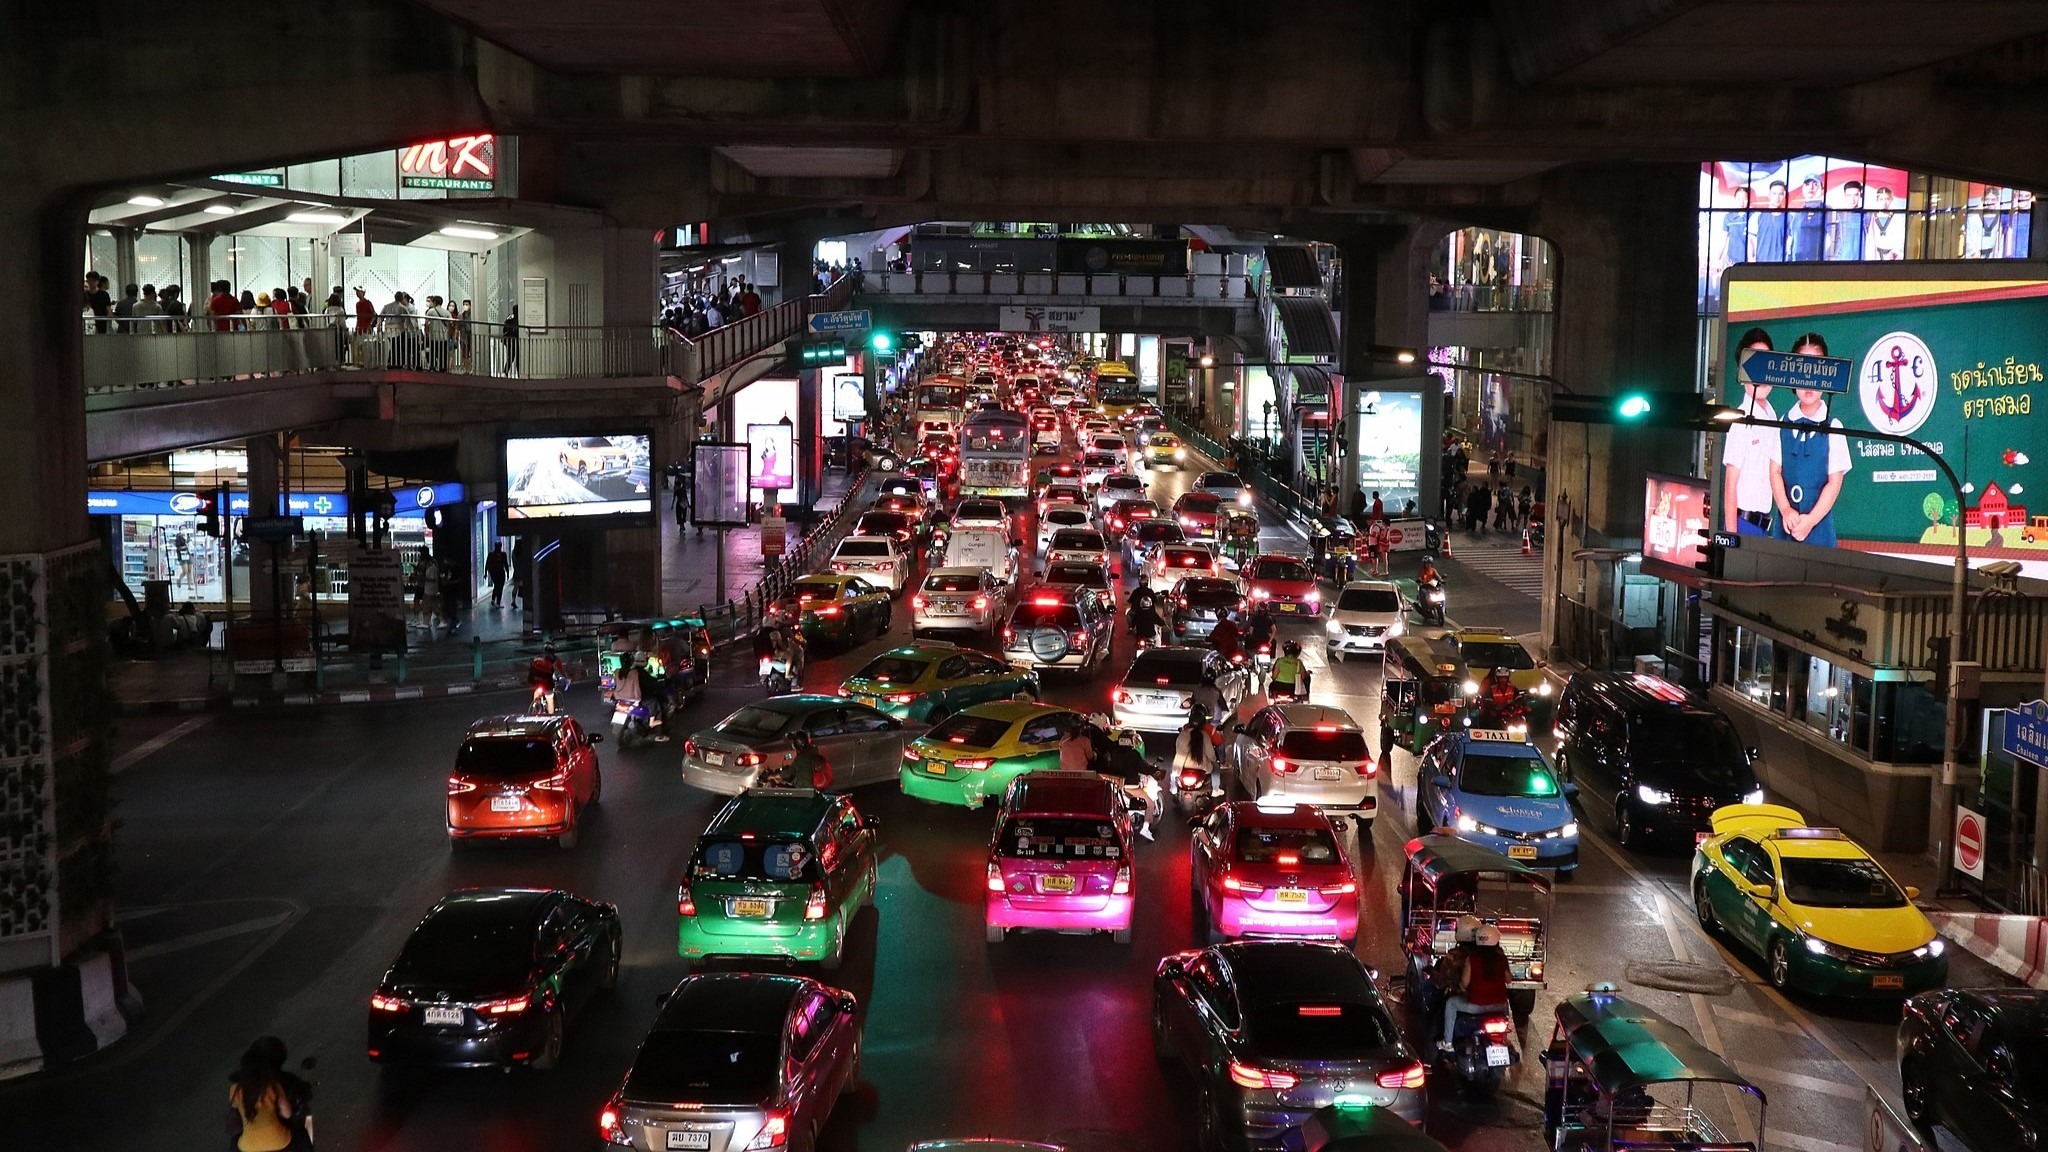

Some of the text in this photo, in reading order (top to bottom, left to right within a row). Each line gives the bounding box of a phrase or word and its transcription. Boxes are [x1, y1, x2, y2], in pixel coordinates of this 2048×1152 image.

[405, 178, 493, 189] RESTAURANTS
[1048, 310, 1076, 321] สยาม
[1765, 375, 1786, 384] Henri
[1789, 378, 1817, 387] Dunant
[1951, 356, 2044, 396] ชุดนักเรียน
[1963, 393, 2031, 419] ตราสมอ
[1857, 440, 1894, 457] ใส่สมอ
[1715, 535, 1730, 546] Plan
[1485, 732, 1510, 740] TAXI
[688, 1133, 707, 1143] 7370
